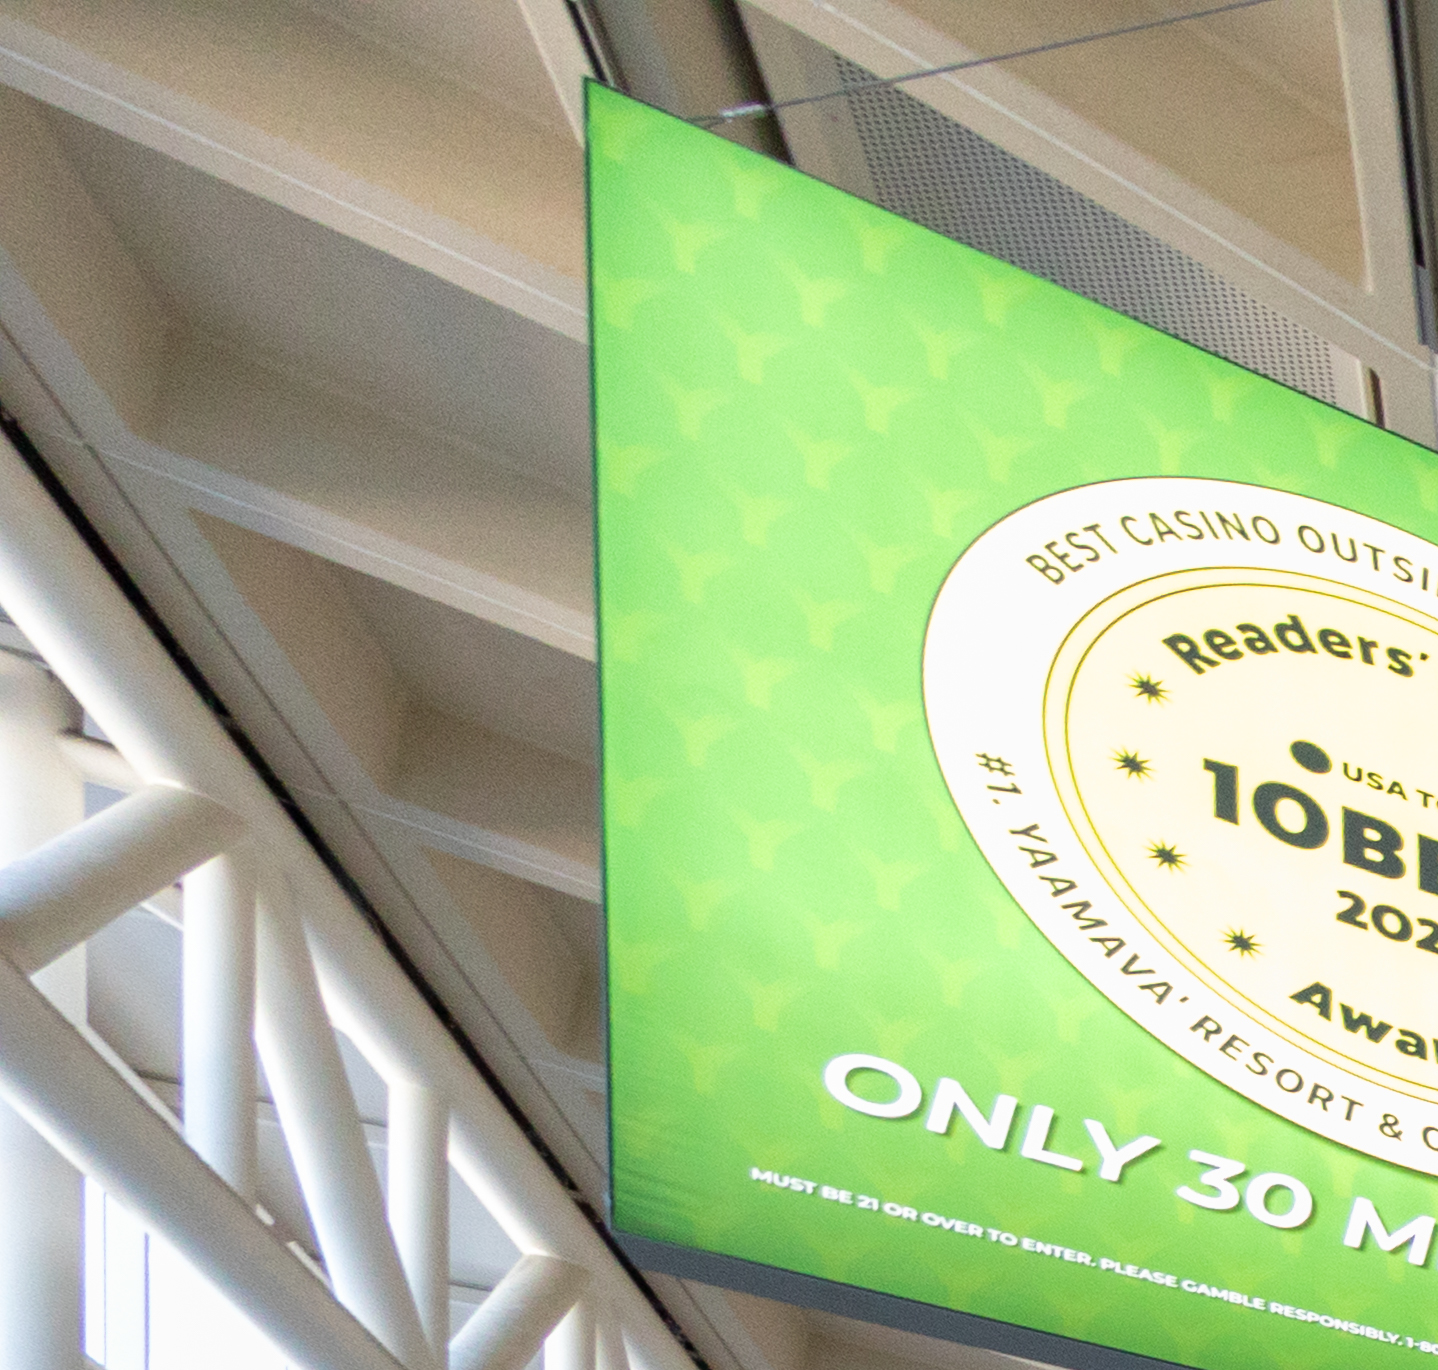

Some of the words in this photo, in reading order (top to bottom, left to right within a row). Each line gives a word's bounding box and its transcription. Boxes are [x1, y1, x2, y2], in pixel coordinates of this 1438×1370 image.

[1026, 524, 1118, 585] BEST
[1120, 510, 1280, 545] CASINO
[1162, 613, 1430, 677] Readers'
[1342, 762, 1408, 800] USA
[1188, 1014, 1365, 1122] RESORT
[1378, 1113, 1405, 1142] &
[822, 1052, 1162, 1183] ONLY
[1175, 1150, 1314, 1230] 30
[750, 1166, 818, 1195] MUST
[821, 1184, 854, 1205] BE
[857, 1194, 879, 1212] 21
[882, 1202, 918, 1222] OR
[920, 1211, 984, 1239] OVER
[987, 1228, 1019, 1247] TO
[1020, 1237, 1097, 1267] ENTER.
[1098, 1257, 1179, 1289] PLEASE
[1180, 1278, 1266, 1311] GAMBLE
[1268, 1300, 1404, 1347] RESPONSIBLY.
